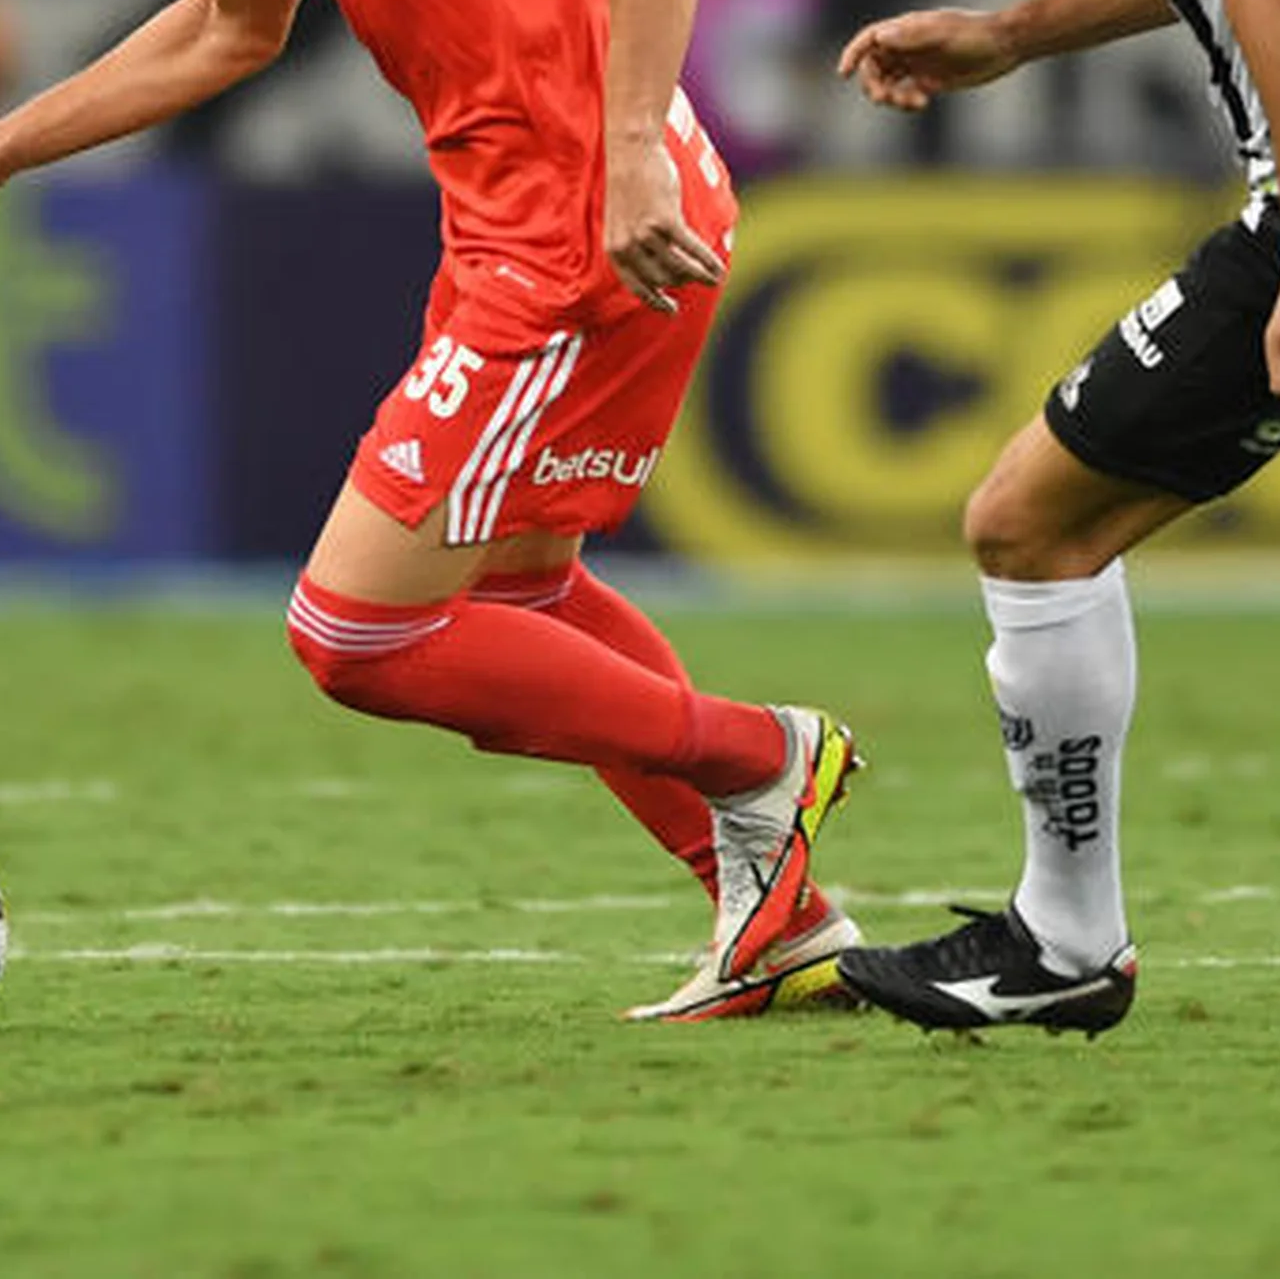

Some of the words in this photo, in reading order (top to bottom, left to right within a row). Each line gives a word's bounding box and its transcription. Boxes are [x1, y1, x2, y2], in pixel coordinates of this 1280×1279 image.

[404, 335, 484, 418] 35
[532, 447, 658, 487] betsul
[1057, 734, 1102, 852] TODOS
